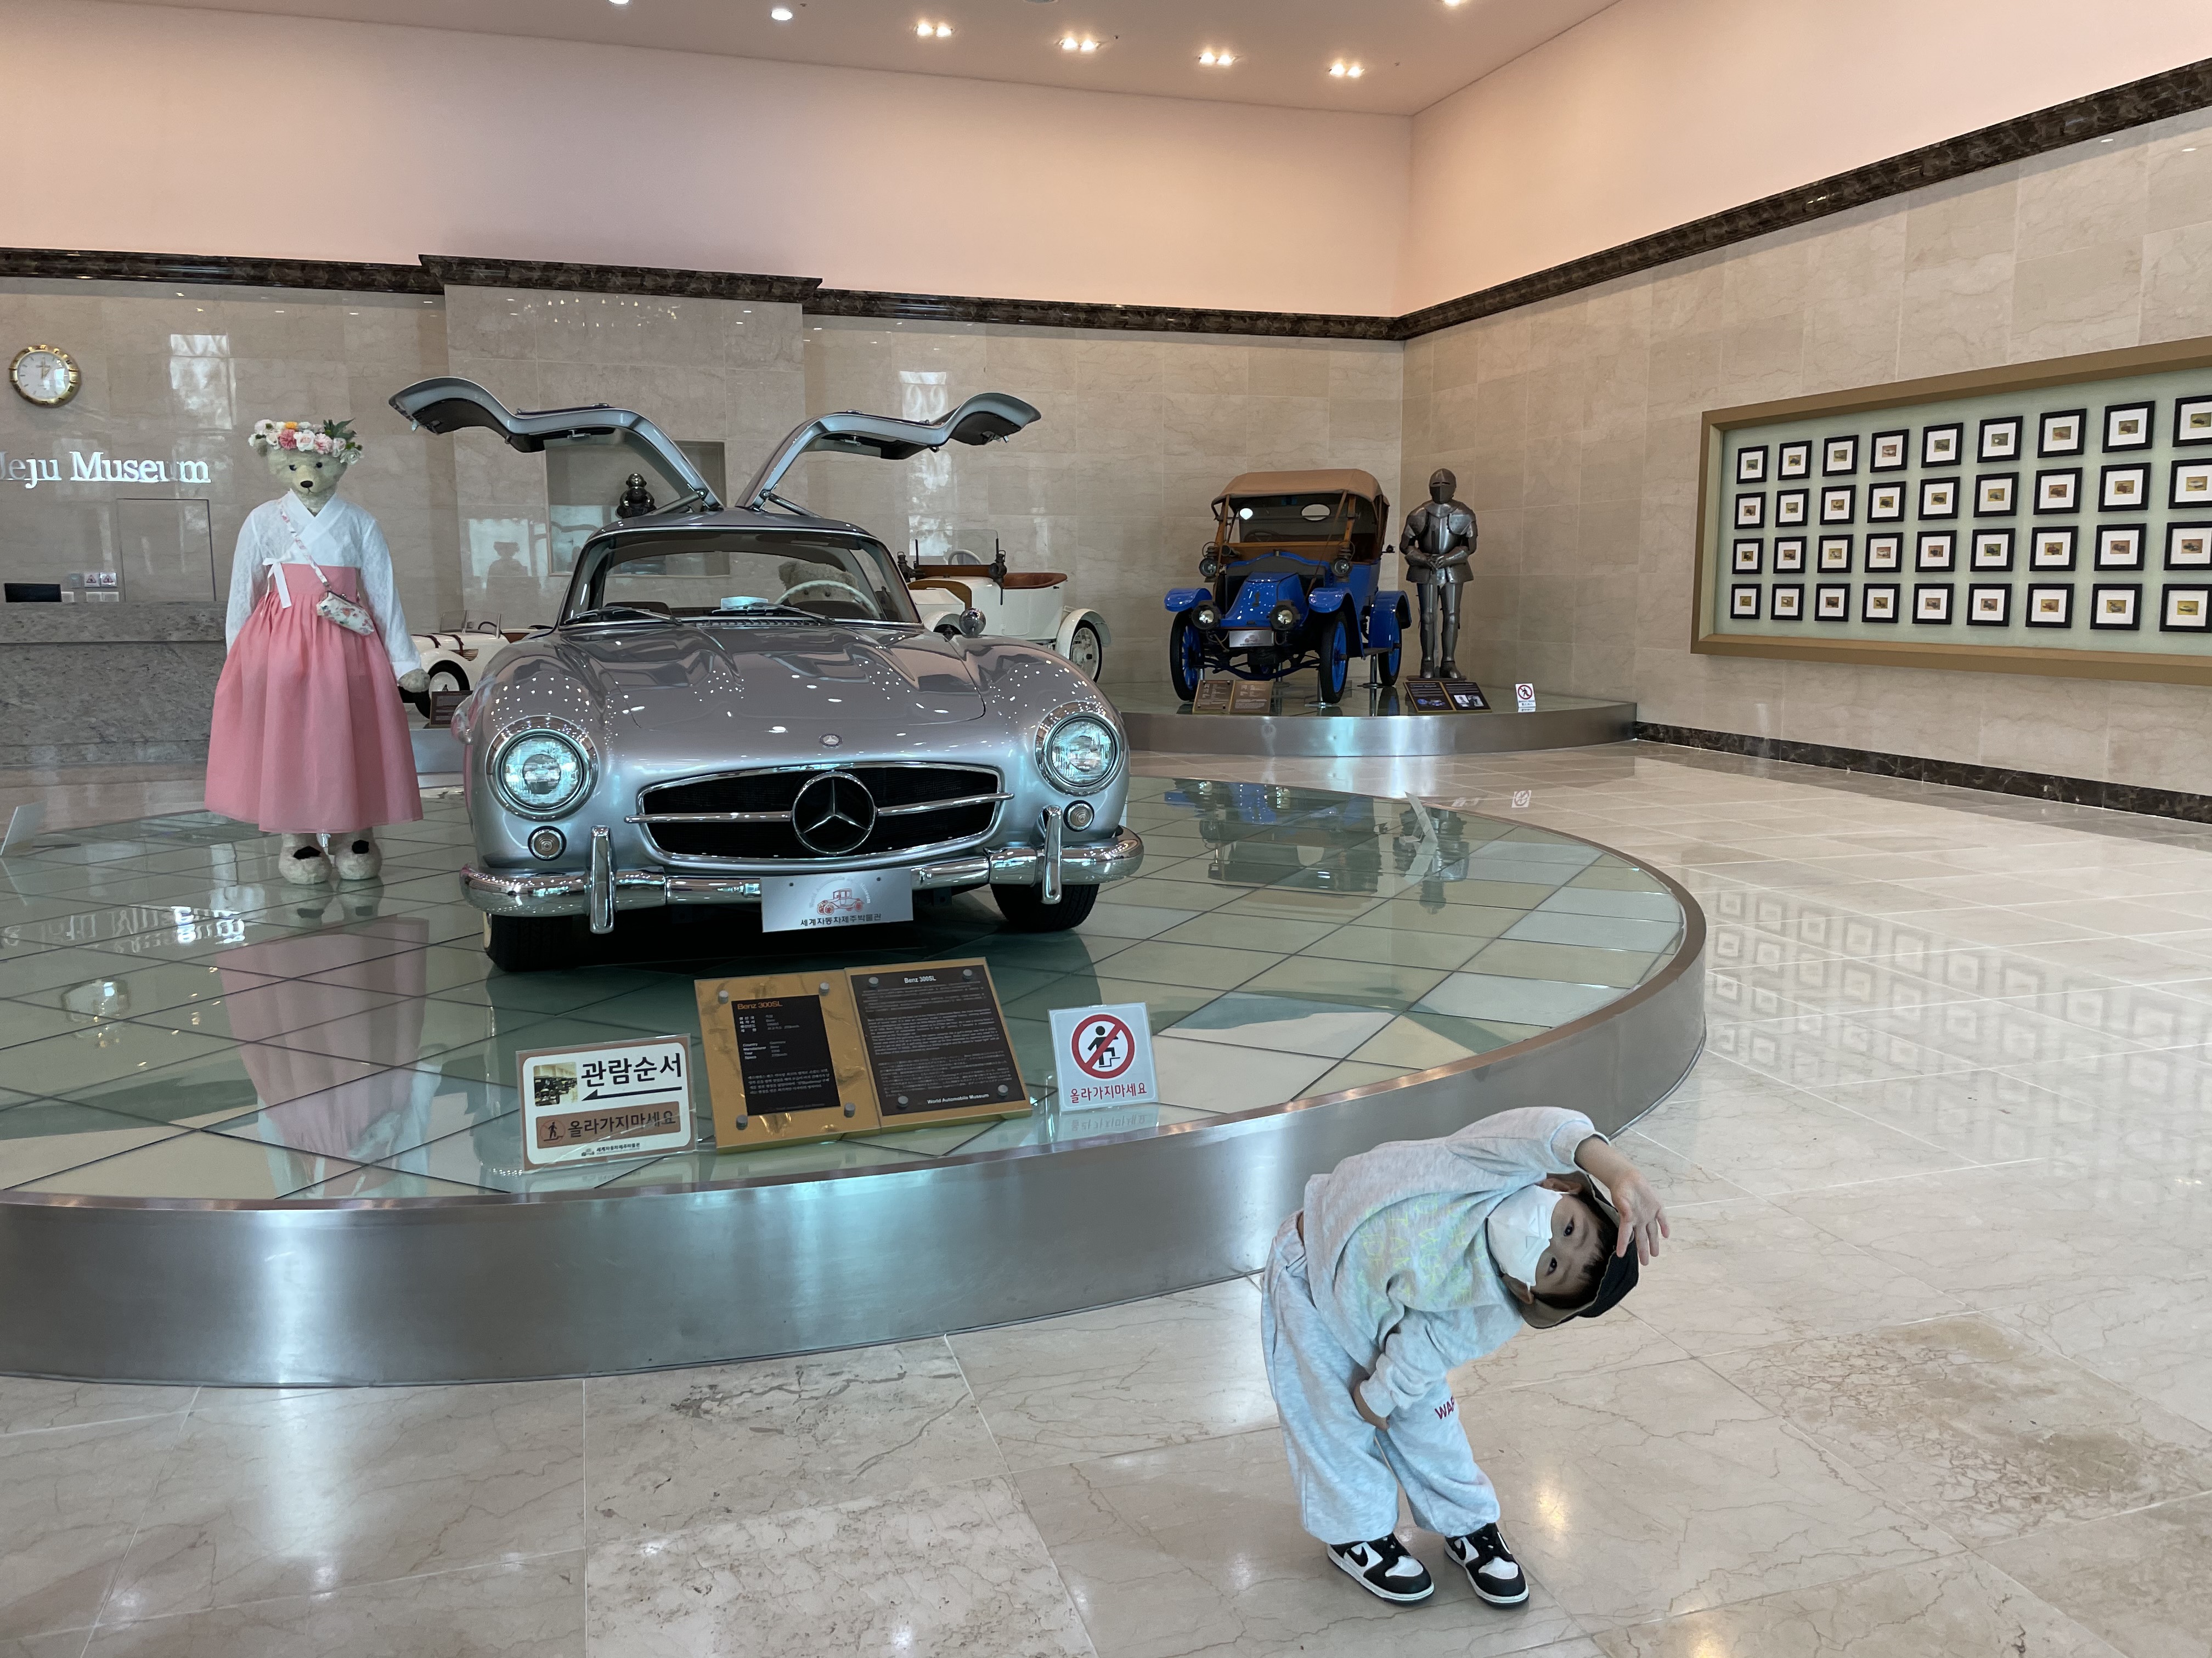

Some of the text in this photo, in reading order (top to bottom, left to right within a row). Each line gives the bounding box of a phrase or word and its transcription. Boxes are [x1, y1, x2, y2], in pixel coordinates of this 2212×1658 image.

[69, 451, 212, 483] Museum
[800, 913, 882, 927] 세계자동차제주박물관
[581, 1053, 681, 1087] 관람순서
[1070, 1082, 1147, 1103] 올라가지마세요
[568, 1110, 676, 1138] 올라가지마세요
